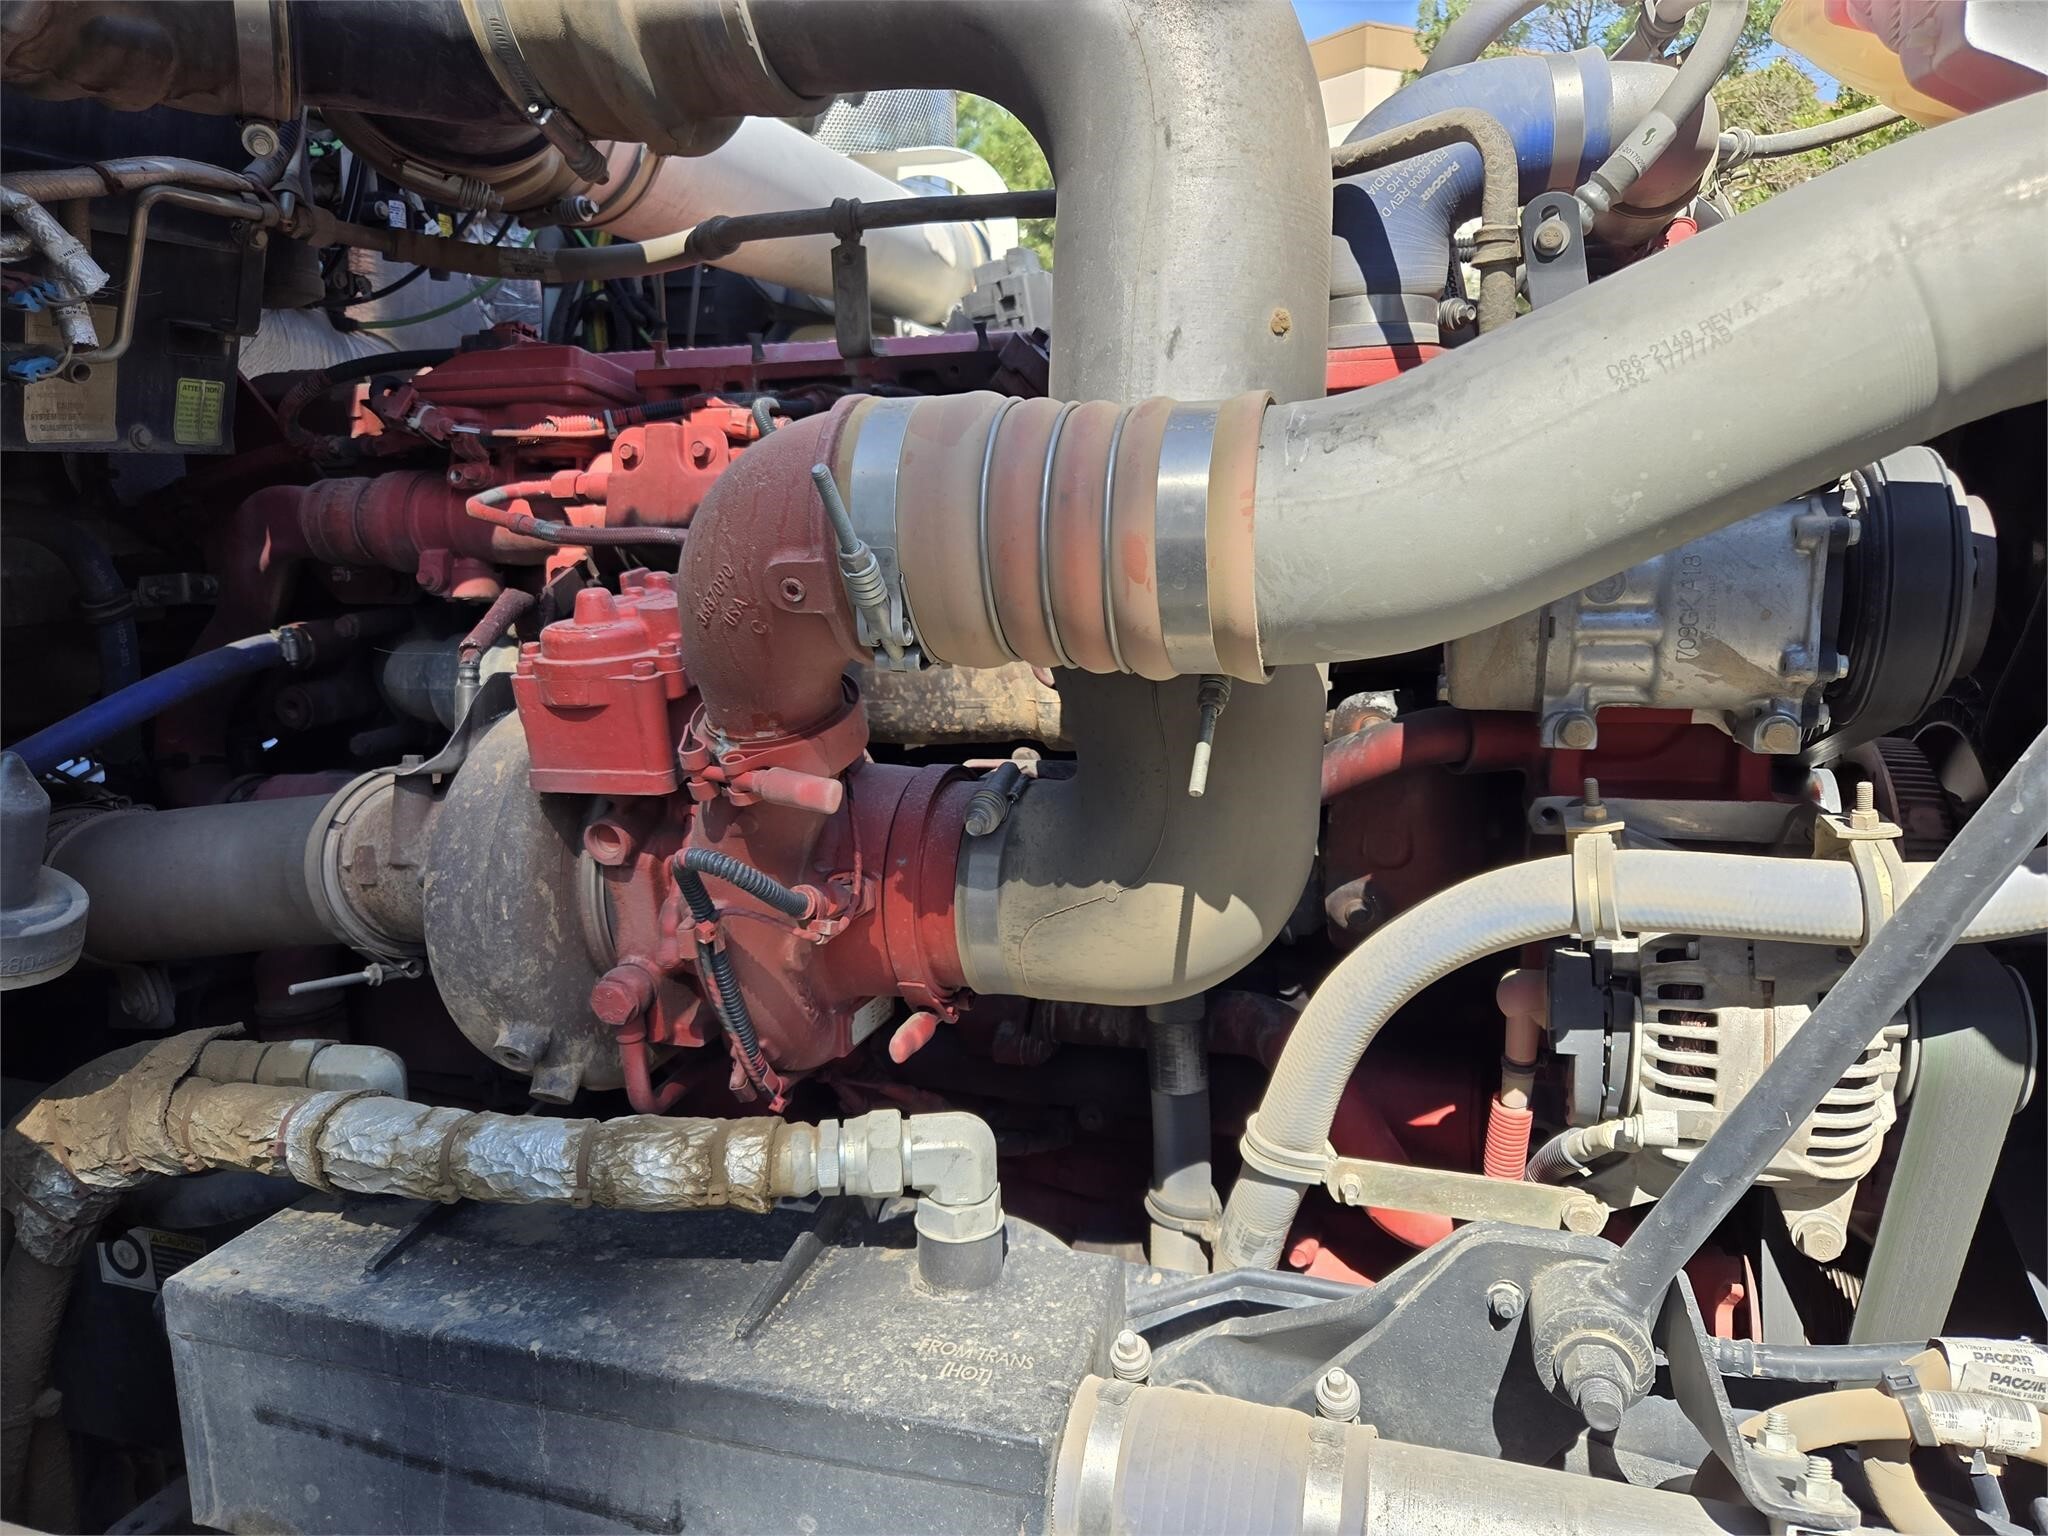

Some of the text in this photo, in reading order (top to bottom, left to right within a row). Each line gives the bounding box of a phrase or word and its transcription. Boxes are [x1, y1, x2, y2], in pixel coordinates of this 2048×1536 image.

[1386, 178, 1404, 193] HG
[1420, 160, 1461, 201] PACCAR
[1390, 188, 1411, 210] REV
[1381, 207, 1392, 217] D
[1606, 329, 1694, 380] D66-2149
[721, 598, 748, 626] USA
[919, 1338, 1036, 1370] FROM TRANS
[940, 1361, 993, 1386] (HOT)
[1988, 1384, 2022, 1397] GENUINE
